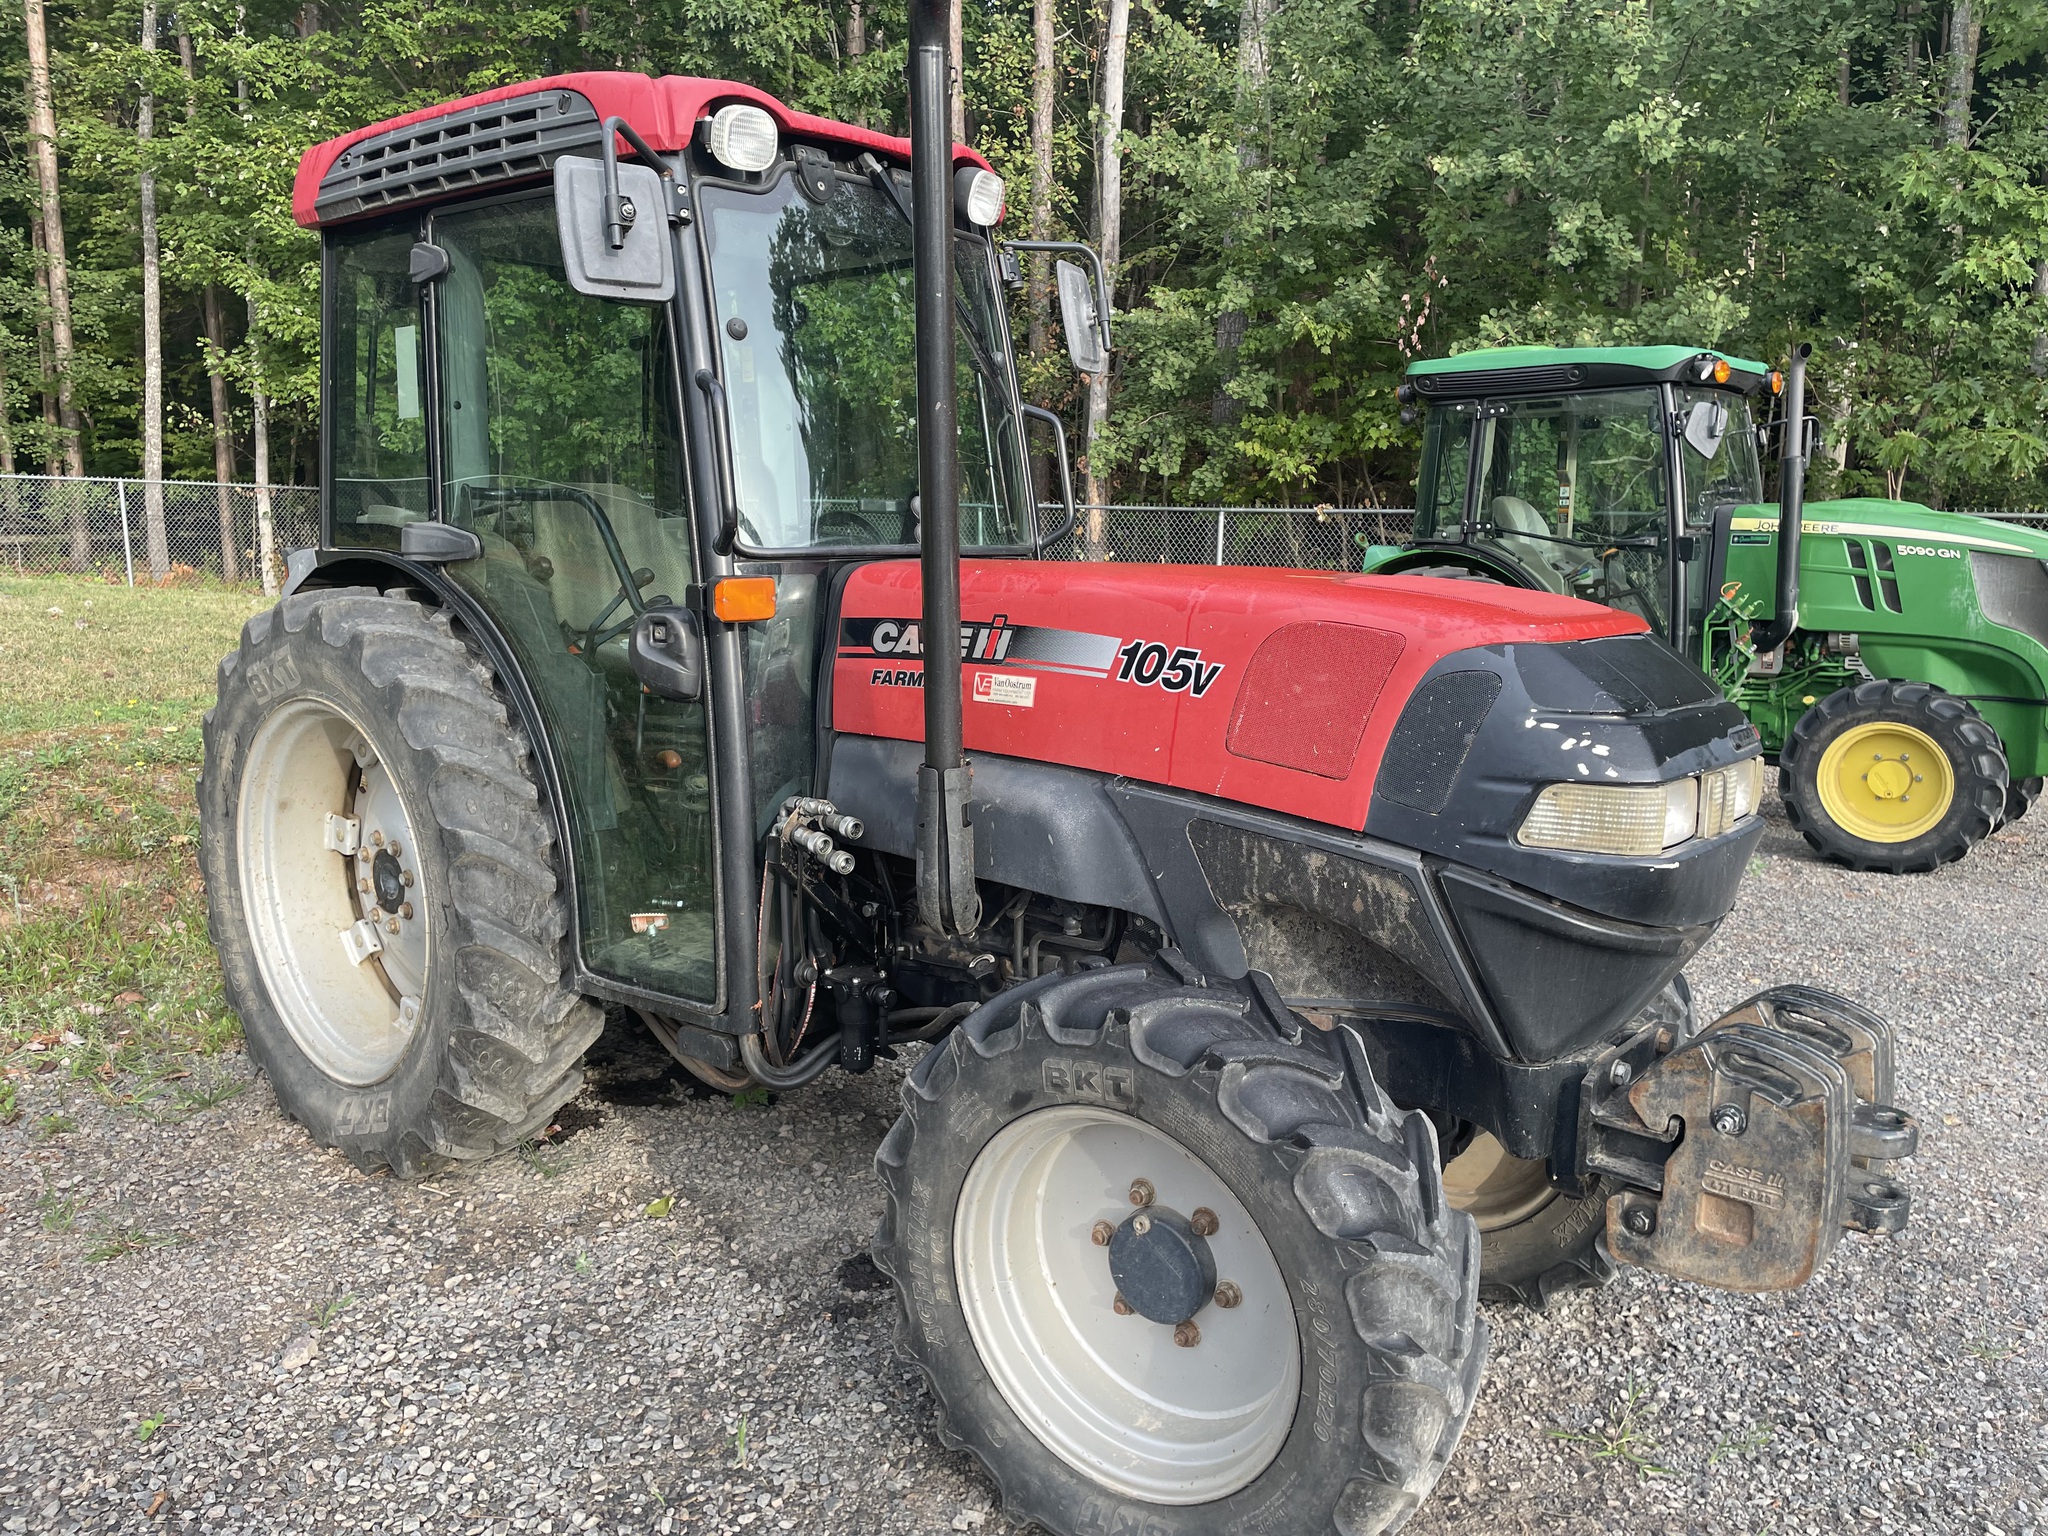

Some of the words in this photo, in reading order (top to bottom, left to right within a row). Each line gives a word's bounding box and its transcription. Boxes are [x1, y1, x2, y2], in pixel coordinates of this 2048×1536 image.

[1754, 520, 1780, 531] JOH
[1800, 522, 1840, 533] EERE
[1896, 544, 1936, 557] 5090
[1937, 548, 1961, 559] GN
[872, 620, 974, 660] CAE
[247, 651, 298, 701] BKT
[871, 668, 925, 688] FARM
[1043, 1063, 1131, 1099] BKT
[336, 1096, 390, 1128] BKT
[1708, 1159, 1764, 1183] CASE
[907, 1175, 932, 1259] MAX
[909, 1260, 947, 1348] AGRI
[1300, 1278, 1338, 1443] 280/70R20
